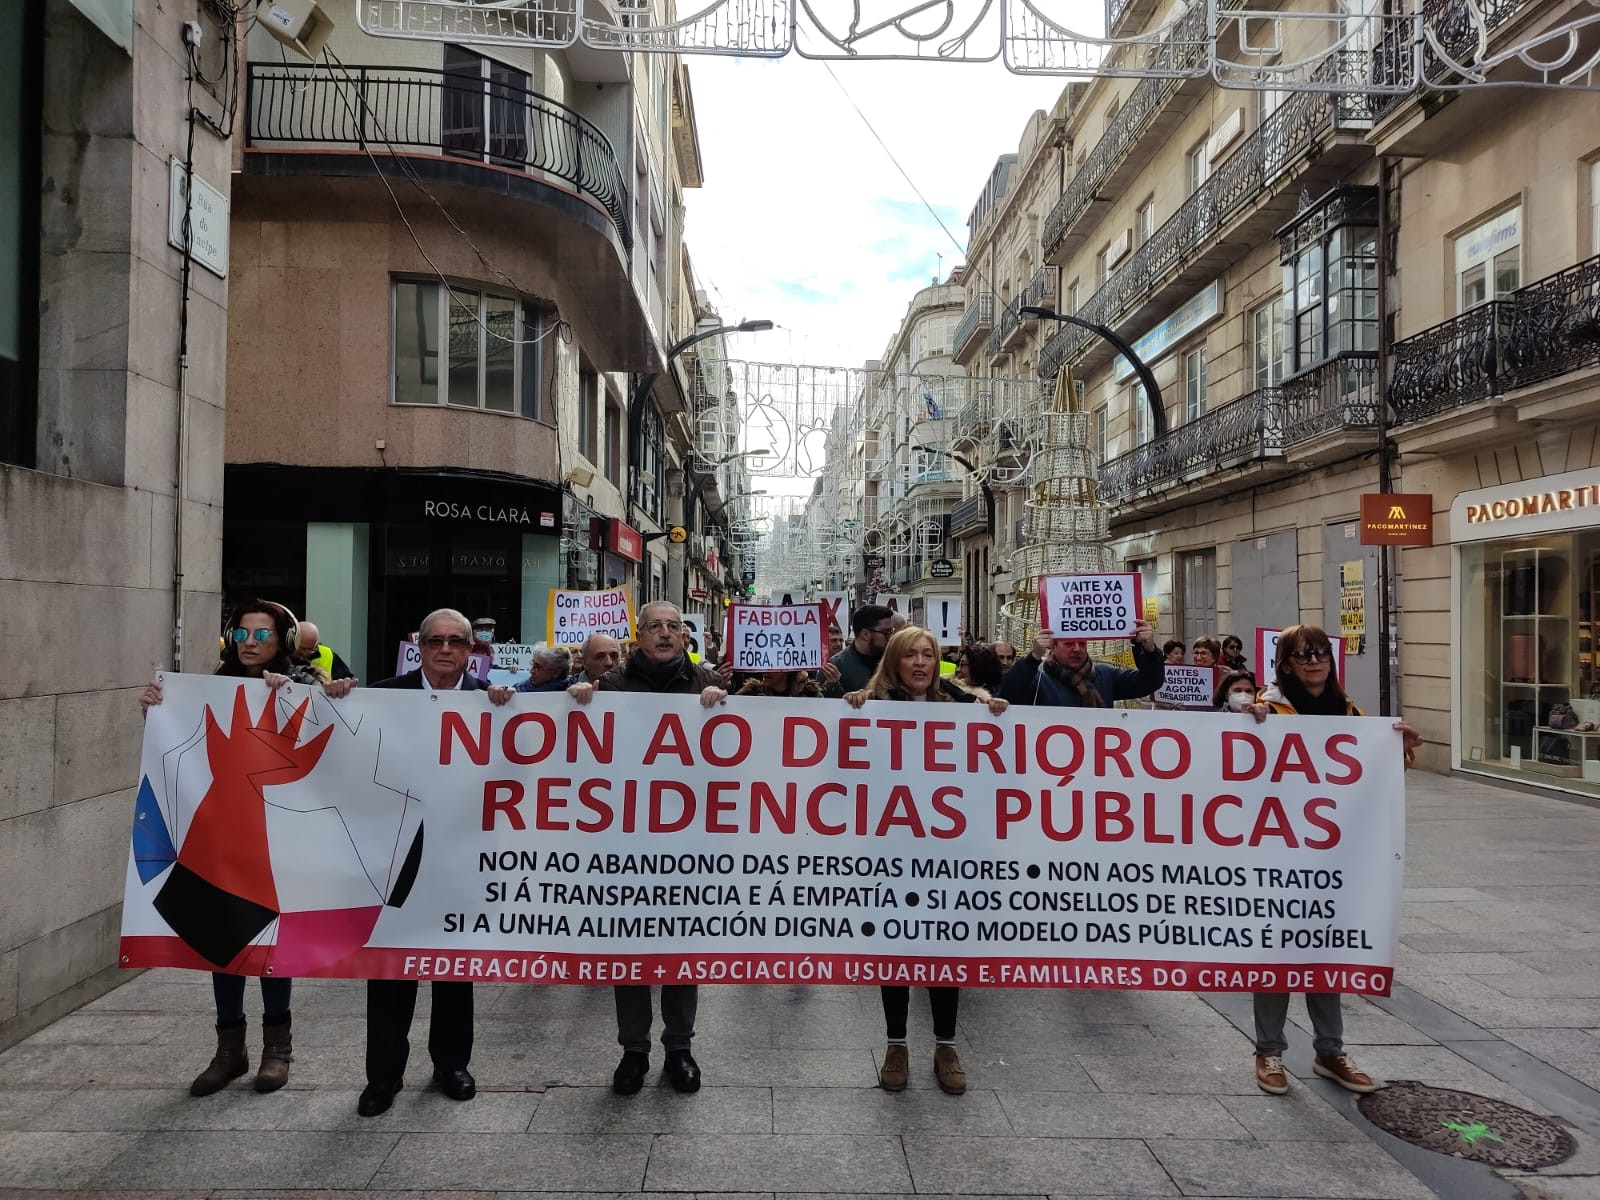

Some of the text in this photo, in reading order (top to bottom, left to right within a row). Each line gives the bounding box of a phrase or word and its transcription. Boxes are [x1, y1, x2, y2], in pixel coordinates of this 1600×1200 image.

[425, 500, 472, 519] ROSA
[477, 506, 531, 524] CLARÁ
[1466, 485, 1600, 524] PACOMARTI
[1061, 580, 1123, 592] VAITE XA
[556, 591, 626, 608] Con RUEDA
[1063, 593, 1122, 605] ARROYO
[559, 609, 628, 627] e FABIOLA
[738, 609, 817, 626] FABIOLA
[1059, 606, 1126, 619] TI ERES O
[1061, 619, 1126, 632] ESCOLLO
[555, 631, 584, 643] TODO
[744, 629, 795, 648] FÓRA
[499, 657, 519, 666] TEN
[740, 647, 773, 668] FÓRA,
[777, 647, 808, 666] FÓRA
[1166, 669, 1199, 677] ANTES
[1166, 685, 1201, 693] AGORA
[439, 711, 1362, 784] NON AO DETERIORO DAS
[483, 775, 1342, 849] RESIDENCIAS PÚBLICAS
[480, 851, 1342, 889] NON AO ABANDONO DAS PERSOAS MAIORES NON AOS MALOS TRATOS
[486, 877, 1335, 919] SI Á TRANSPARENCIA E Á EMPATÍA SI AOS CONSELLOS DE RESIDENCIAS
[444, 911, 1372, 949] SI A UNHA ALIMENTACIÓN DIGNA OUTRO MODELO DAS PÚBLICAS É POSÍBEL
[403, 955, 1386, 992] FEDERACIÓN REDE + ASOCIACIÓN USUARIAS E FAMILIARES DO CRAPD DE VIGO
